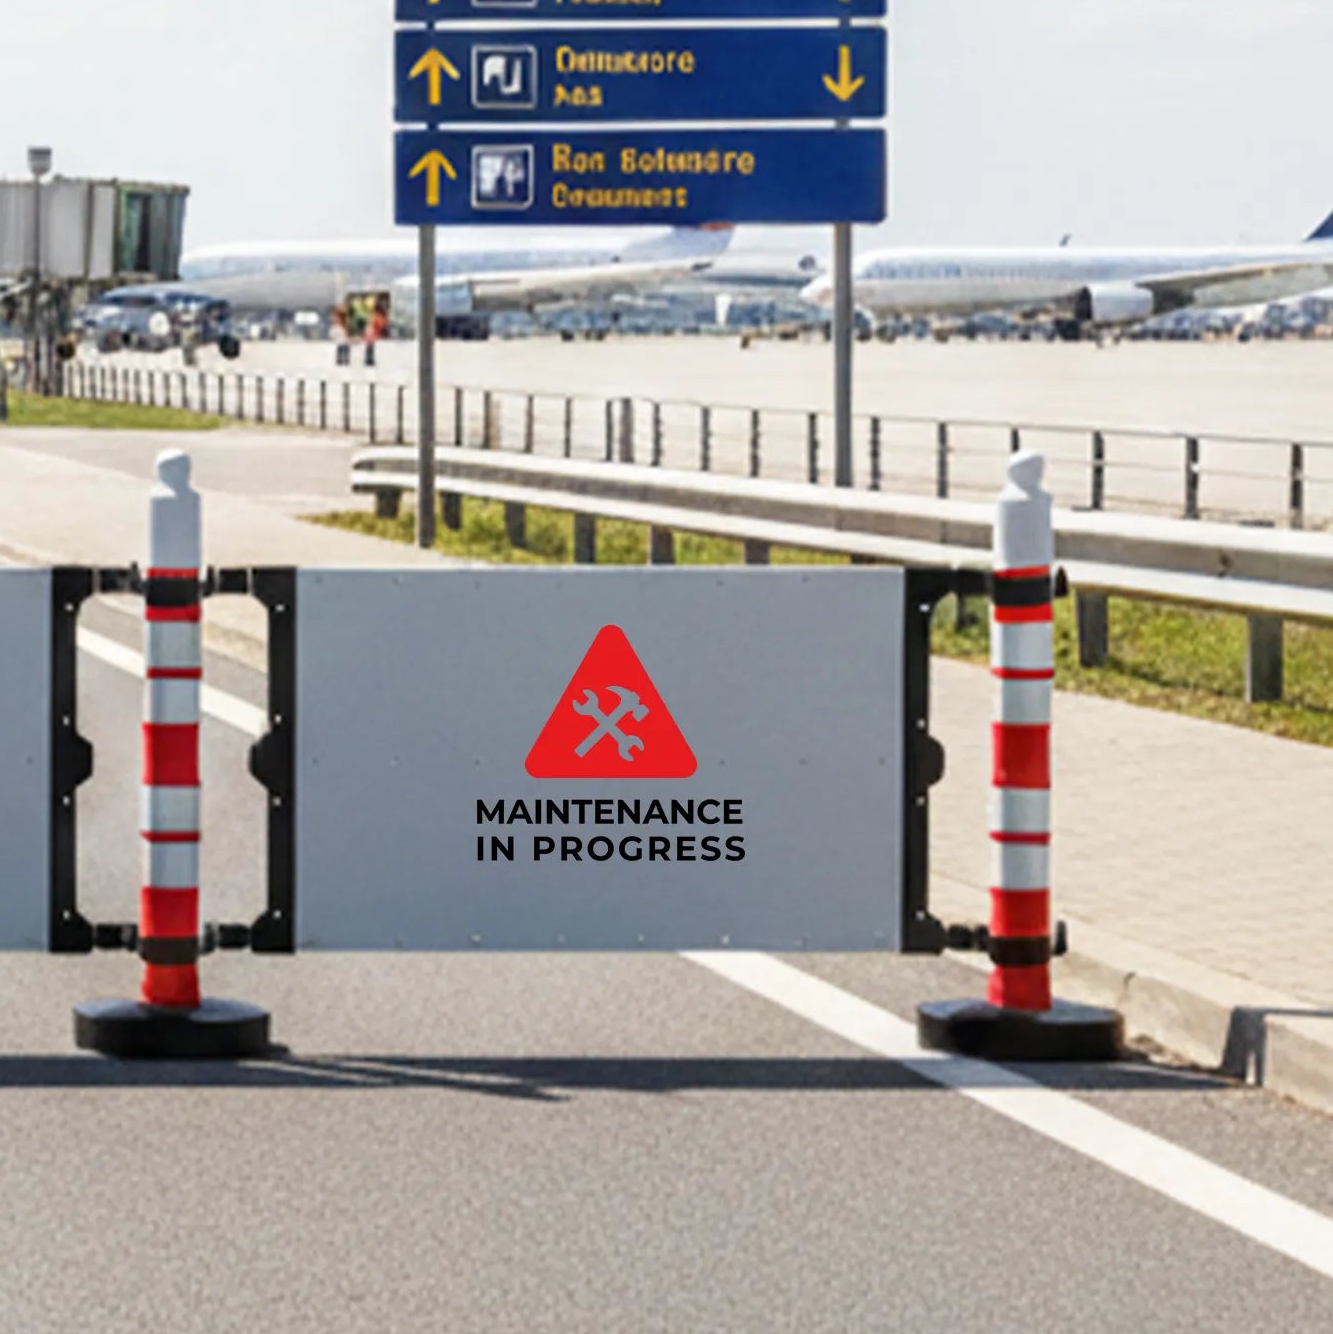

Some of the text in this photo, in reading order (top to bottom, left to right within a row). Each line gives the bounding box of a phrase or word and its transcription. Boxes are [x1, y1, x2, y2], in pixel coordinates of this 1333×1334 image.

[476, 798, 744, 825] MAINTENANCE
[476, 835, 746, 862] IN PROGRESS
